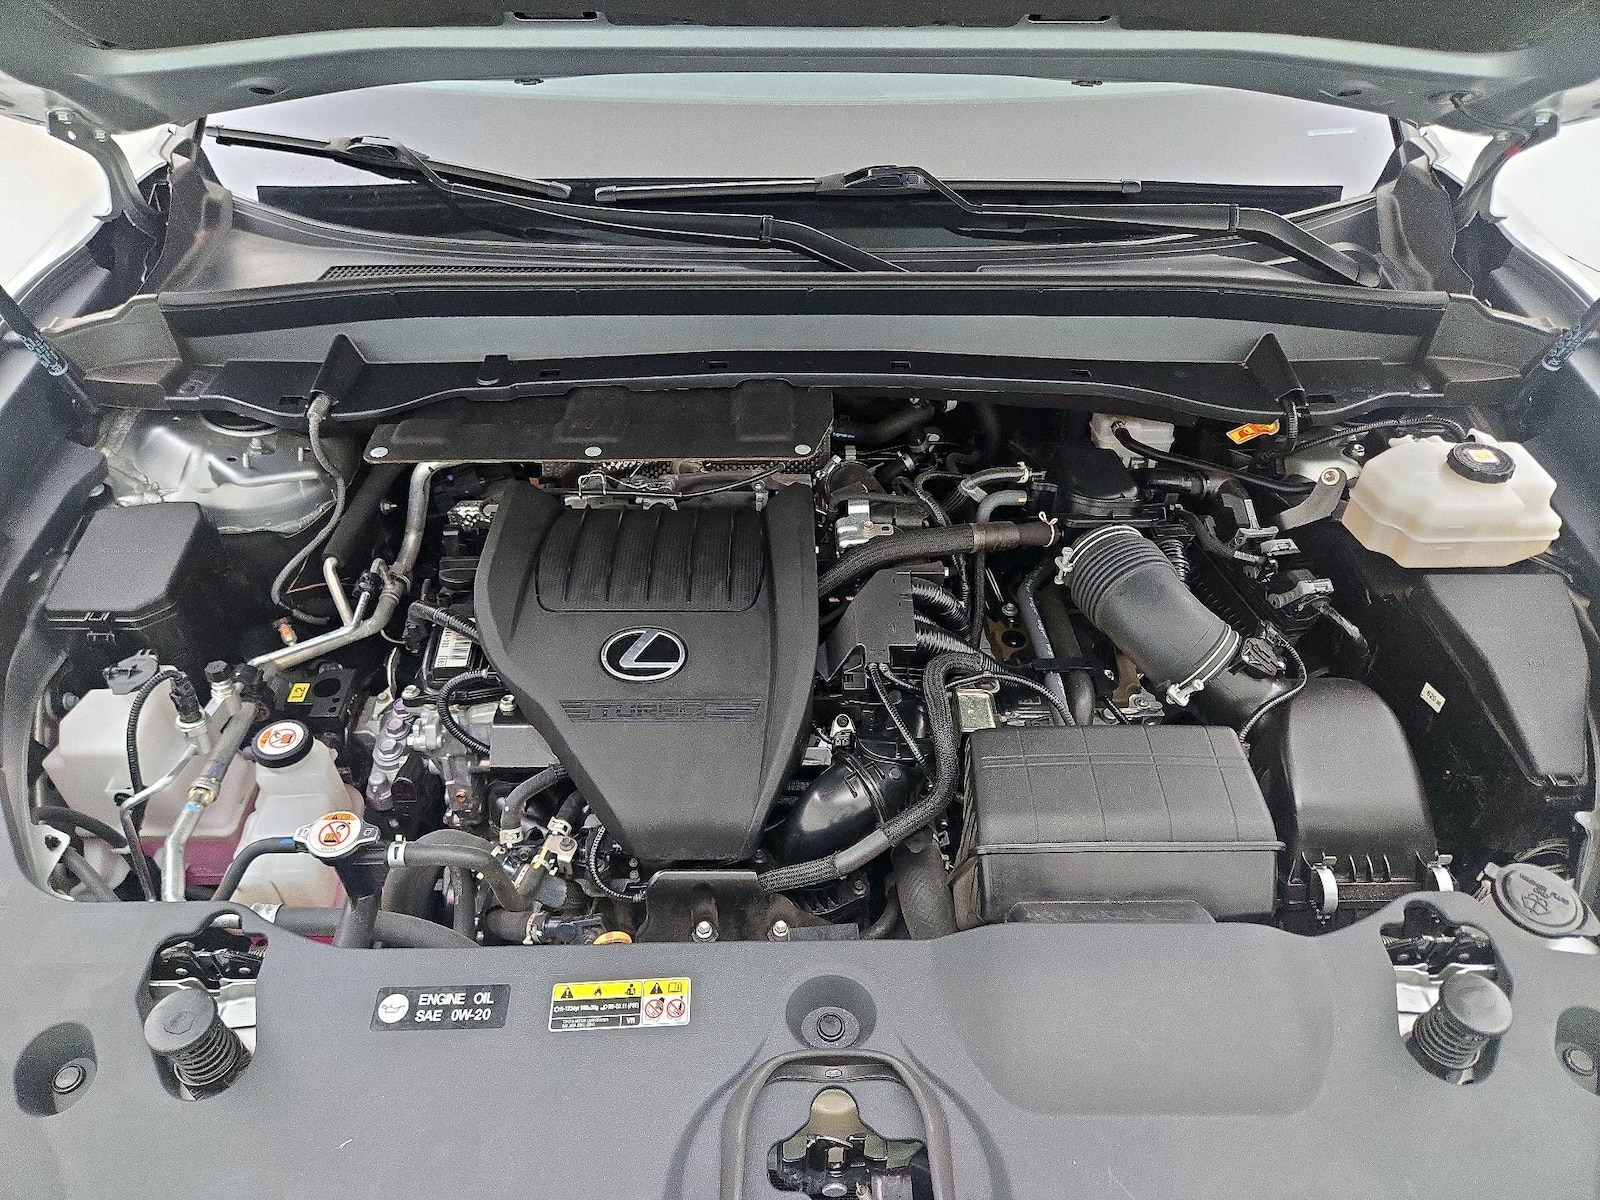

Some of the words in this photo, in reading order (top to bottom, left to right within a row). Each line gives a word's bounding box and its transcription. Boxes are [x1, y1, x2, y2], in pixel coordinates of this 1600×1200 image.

[418, 993, 466, 1006] ENGINE
[473, 992, 494, 1005] OIL
[415, 1009, 443, 1022] SAE
[451, 1008, 491, 1021] 0W-20
